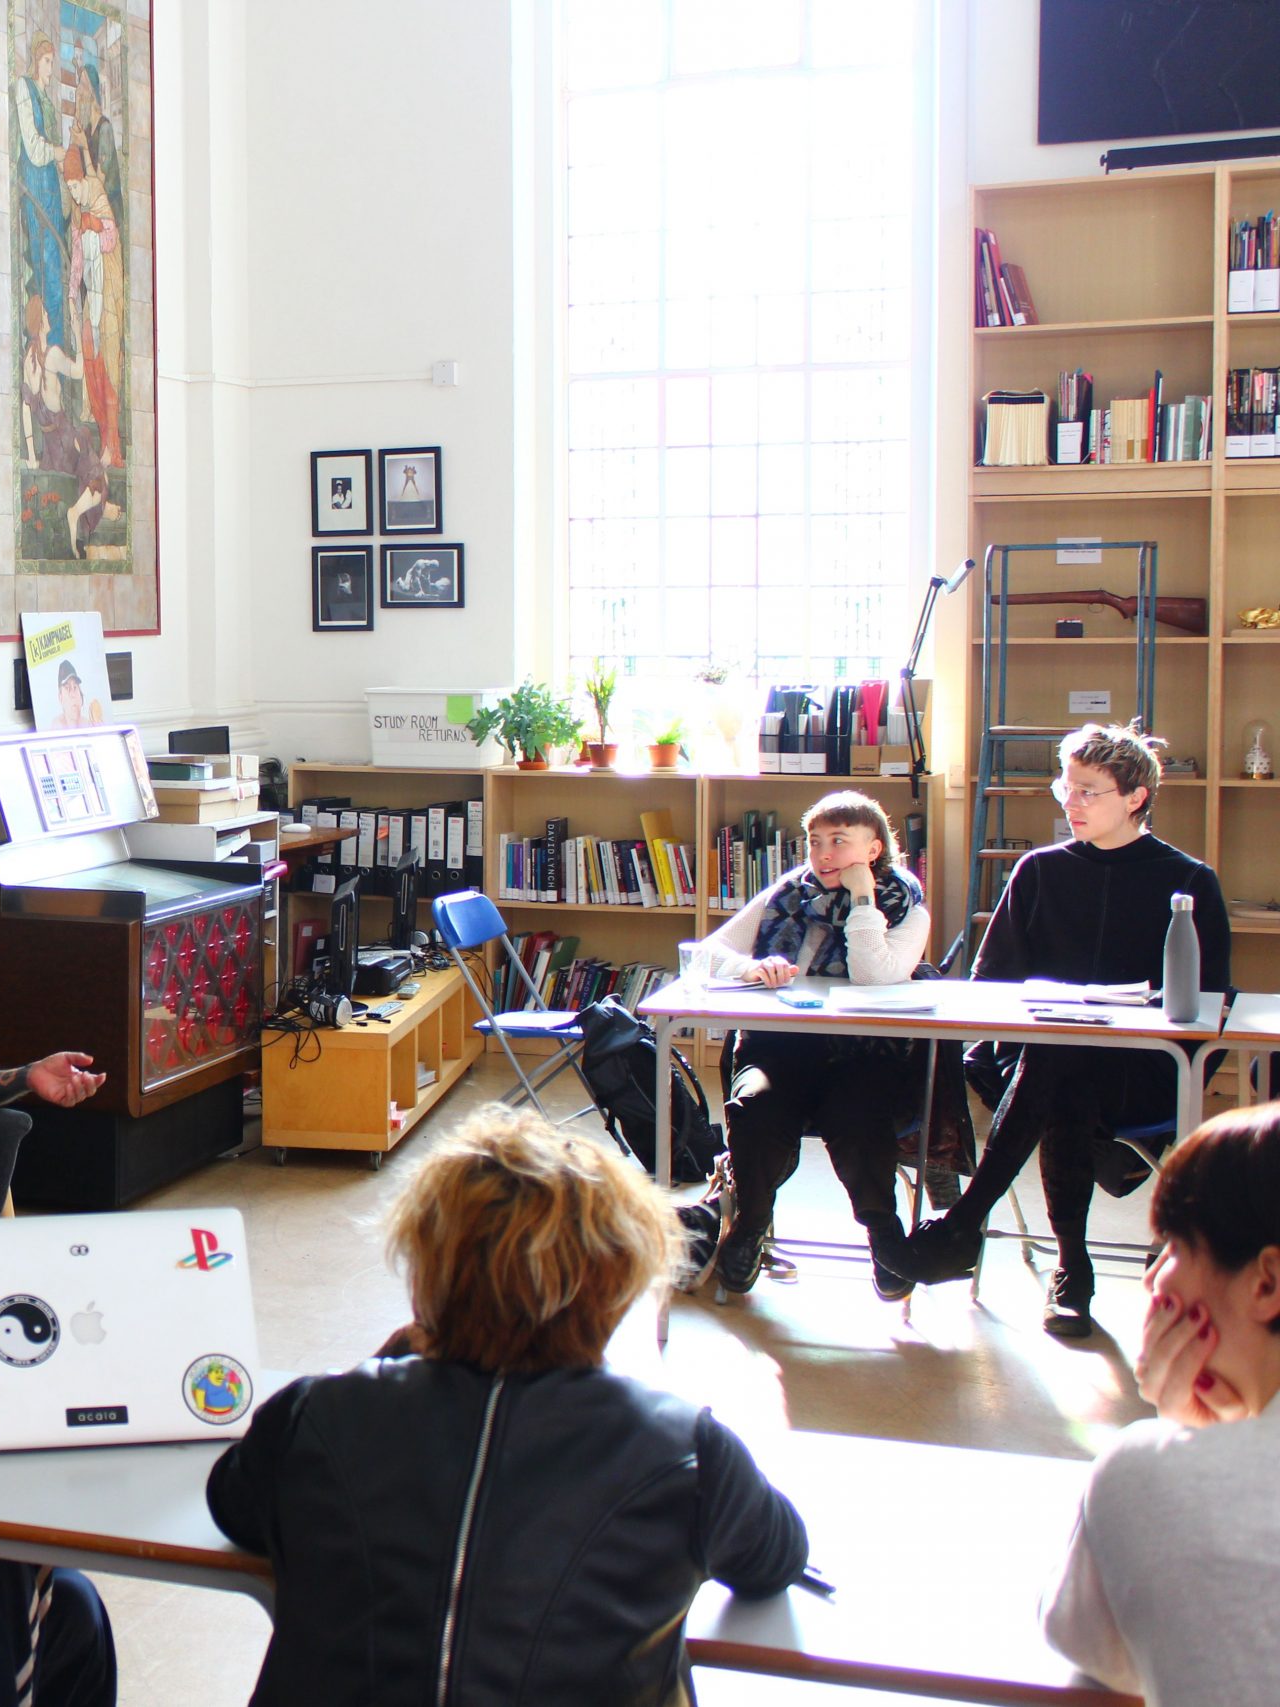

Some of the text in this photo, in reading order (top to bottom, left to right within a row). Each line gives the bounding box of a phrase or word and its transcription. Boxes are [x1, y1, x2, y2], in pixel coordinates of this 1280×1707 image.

[374, 714, 438, 729] STUDY ROOM
[418, 728, 467, 743] RETURNS
[547, 824, 555, 888] DAVID LYNCH
[78, 1412, 117, 1422] acaia
